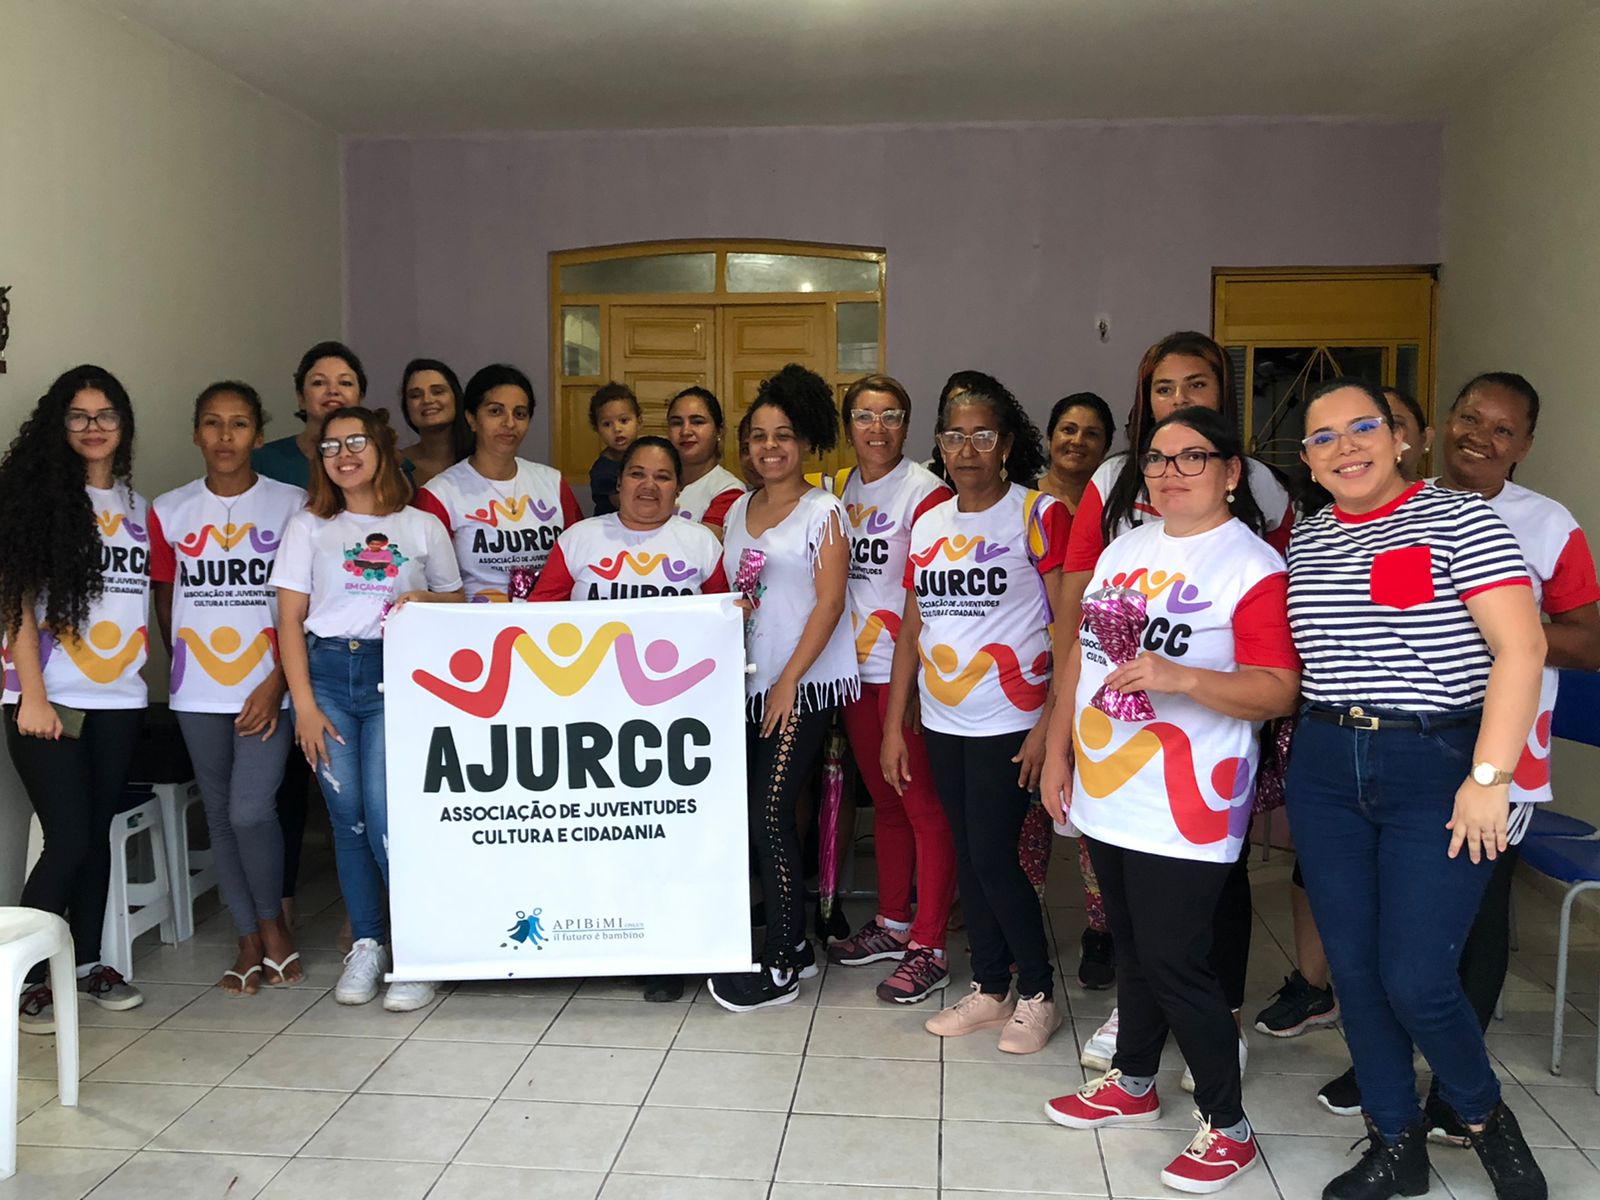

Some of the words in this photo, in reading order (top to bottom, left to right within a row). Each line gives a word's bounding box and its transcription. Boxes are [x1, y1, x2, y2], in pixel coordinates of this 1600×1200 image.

[100, 545, 150, 576] URC
[588, 582, 693, 600] AJUR
[915, 566, 1007, 597] JURCC
[919, 598, 948, 608] OCIAÇÃO
[949, 609, 985, 617] CIDADANIA
[423, 717, 712, 793] AJURCC
[440, 801, 556, 822] ASSOCIAÇÃO
[560, 803, 580, 818] DE
[584, 799, 697, 818] JUVENTUDES
[472, 828, 554, 845] CULTURA
[558, 828, 568, 842] E
[571, 824, 666, 842] CIDADANIA
[553, 917, 622, 930] APIBiMI
[553, 933, 560, 941] il
[562, 933, 592, 941] futuro
[602, 931, 645, 940] bambino
